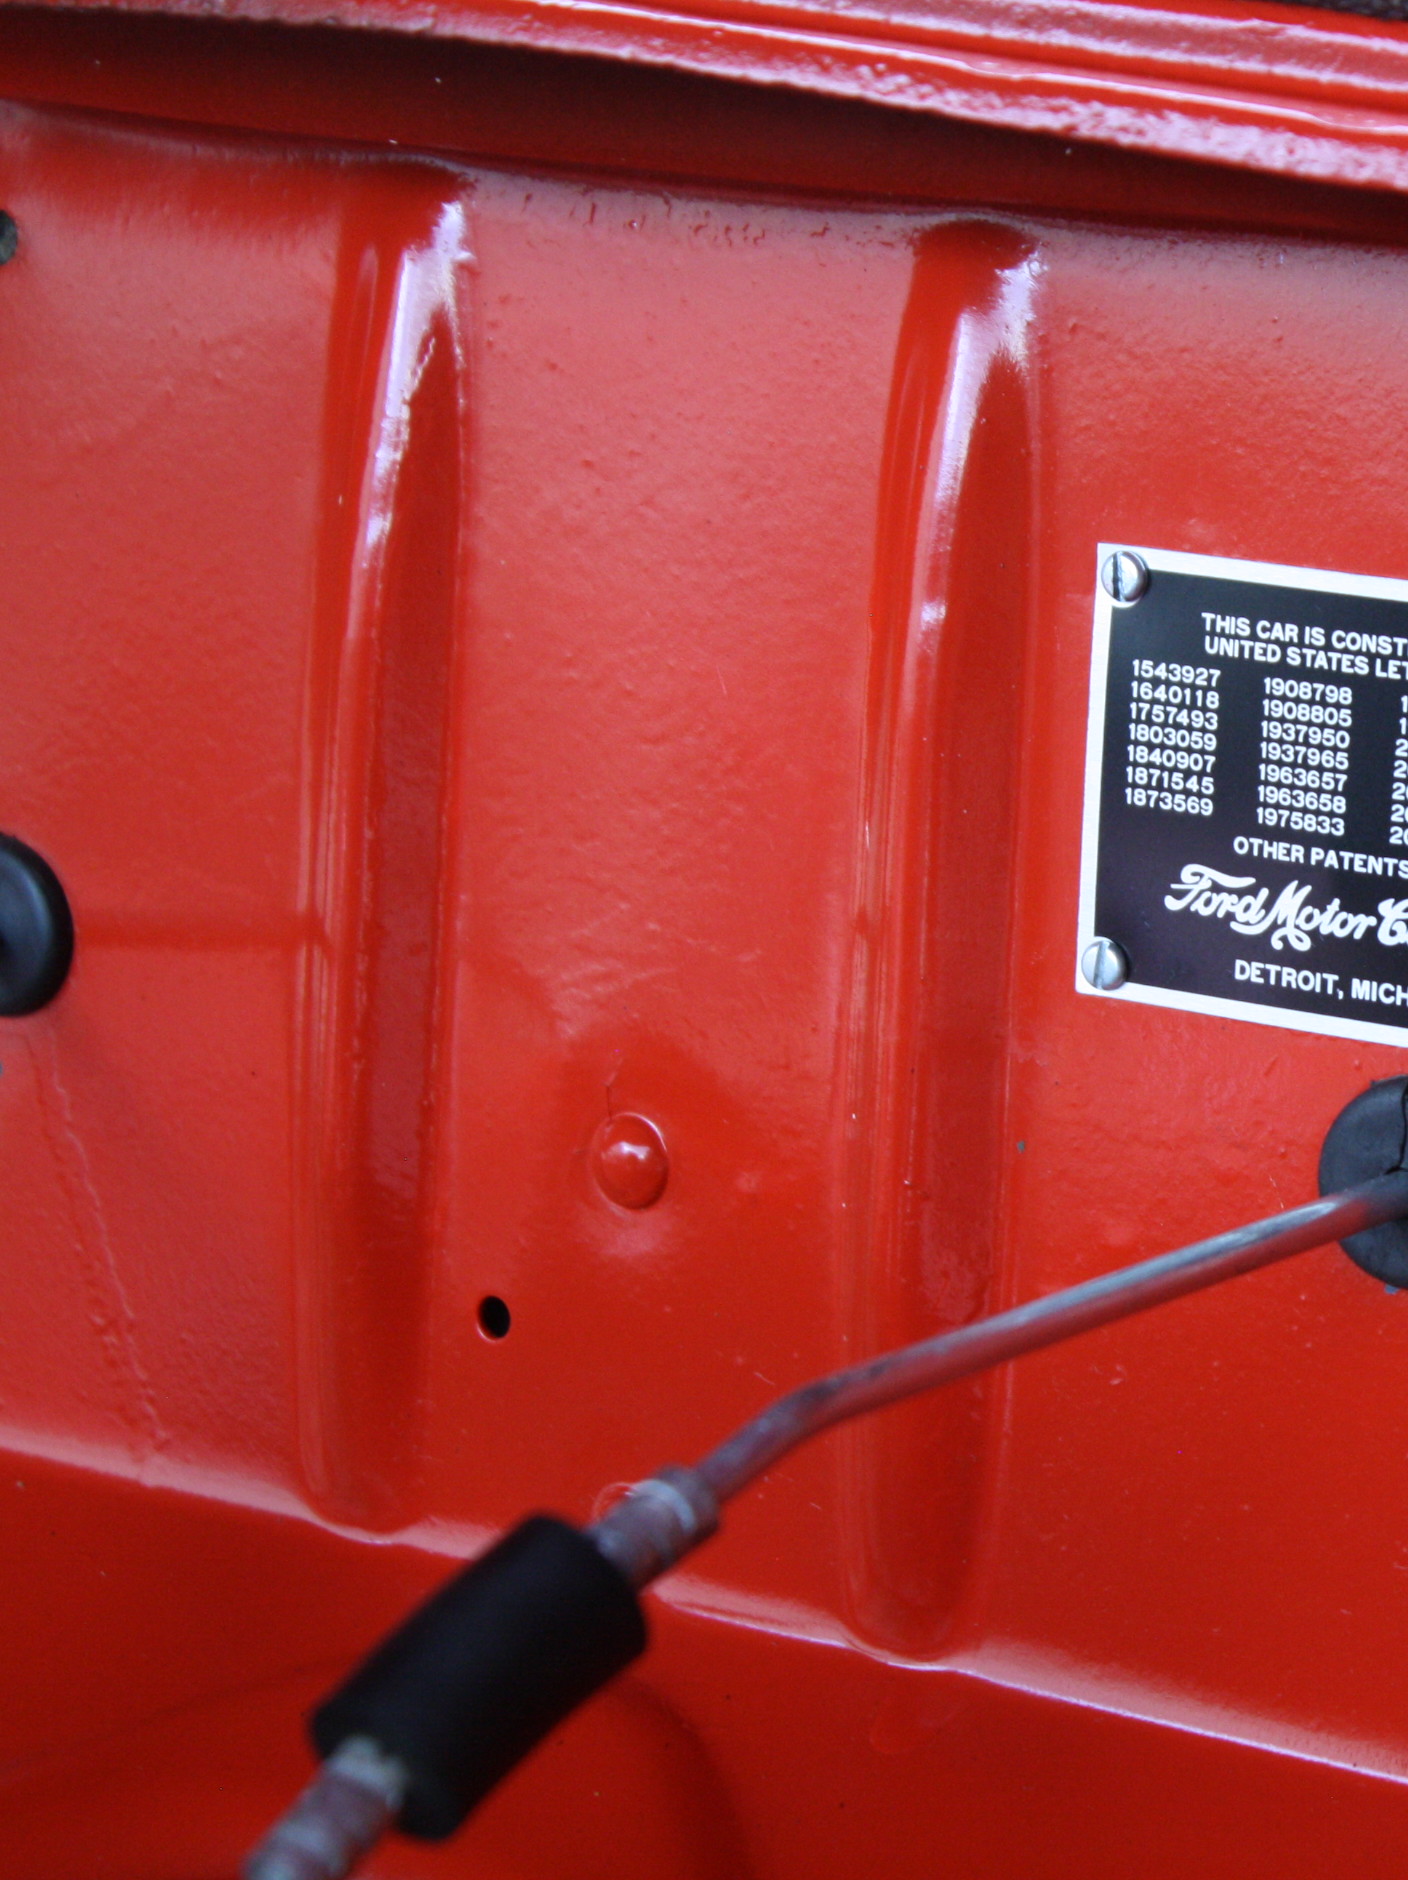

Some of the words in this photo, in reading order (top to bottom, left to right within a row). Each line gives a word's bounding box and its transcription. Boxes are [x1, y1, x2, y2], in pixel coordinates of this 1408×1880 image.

[1201, 612, 1250, 636] THIS
[1256, 620, 1298, 643] CAR
[1304, 626, 1326, 646] IS
[1205, 635, 1281, 663] UNITED
[1286, 646, 1369, 675] STATES
[1132, 659, 1221, 687] 1543927
[1131, 681, 1219, 709] 1640118
[1264, 677, 1352, 705] 1908798
[1130, 702, 1218, 730] 1757493
[1262, 699, 1352, 727] 1908805
[1129, 723, 1217, 751] 1803059
[1261, 720, 1350, 748] 1937950
[1127, 744, 1216, 772] 1840907
[1260, 741, 1348, 770] 1937965
[1126, 766, 1214, 794] 1871545
[1259, 763, 1348, 792] 1963657
[1125, 787, 1213, 816] 1873569
[1258, 785, 1346, 814] 1963658
[1257, 807, 1345, 836] 1975833
[1234, 836, 1304, 863] OTHER
[1164, 864, 1270, 924] Ford
[1230, 880, 1377, 952] Motor
[1234, 959, 1344, 1000] DETROIT,
